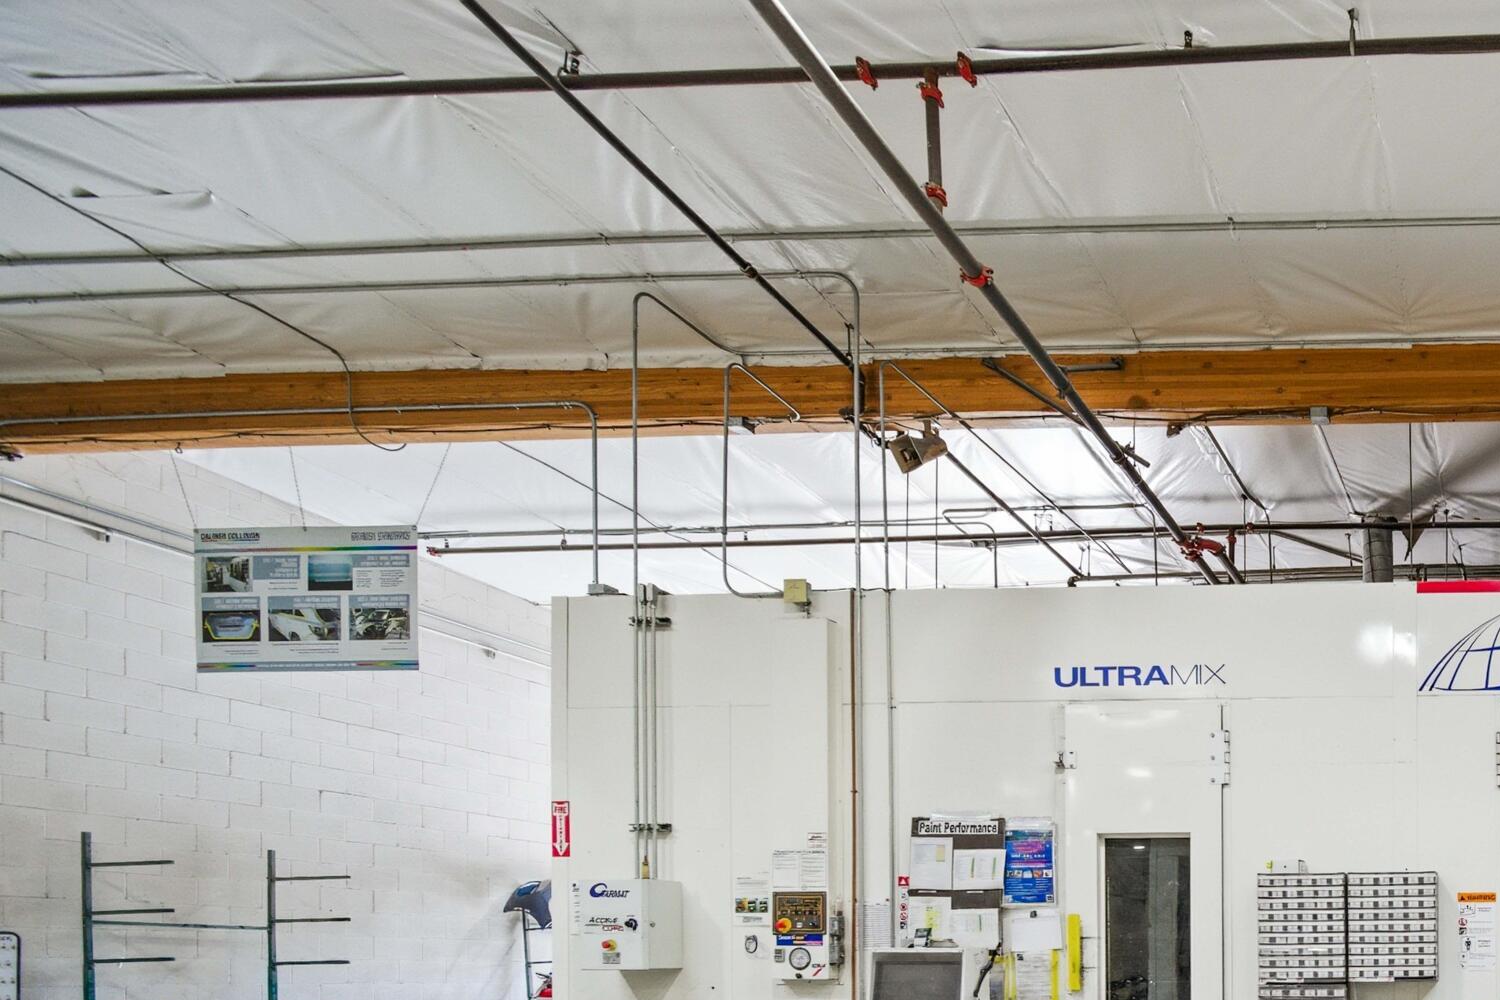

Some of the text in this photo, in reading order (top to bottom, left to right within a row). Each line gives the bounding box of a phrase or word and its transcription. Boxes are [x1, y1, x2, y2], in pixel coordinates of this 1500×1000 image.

[1053, 664, 1227, 688] ULTRAMIX
[919, 822, 998, 834] Paint Performance
